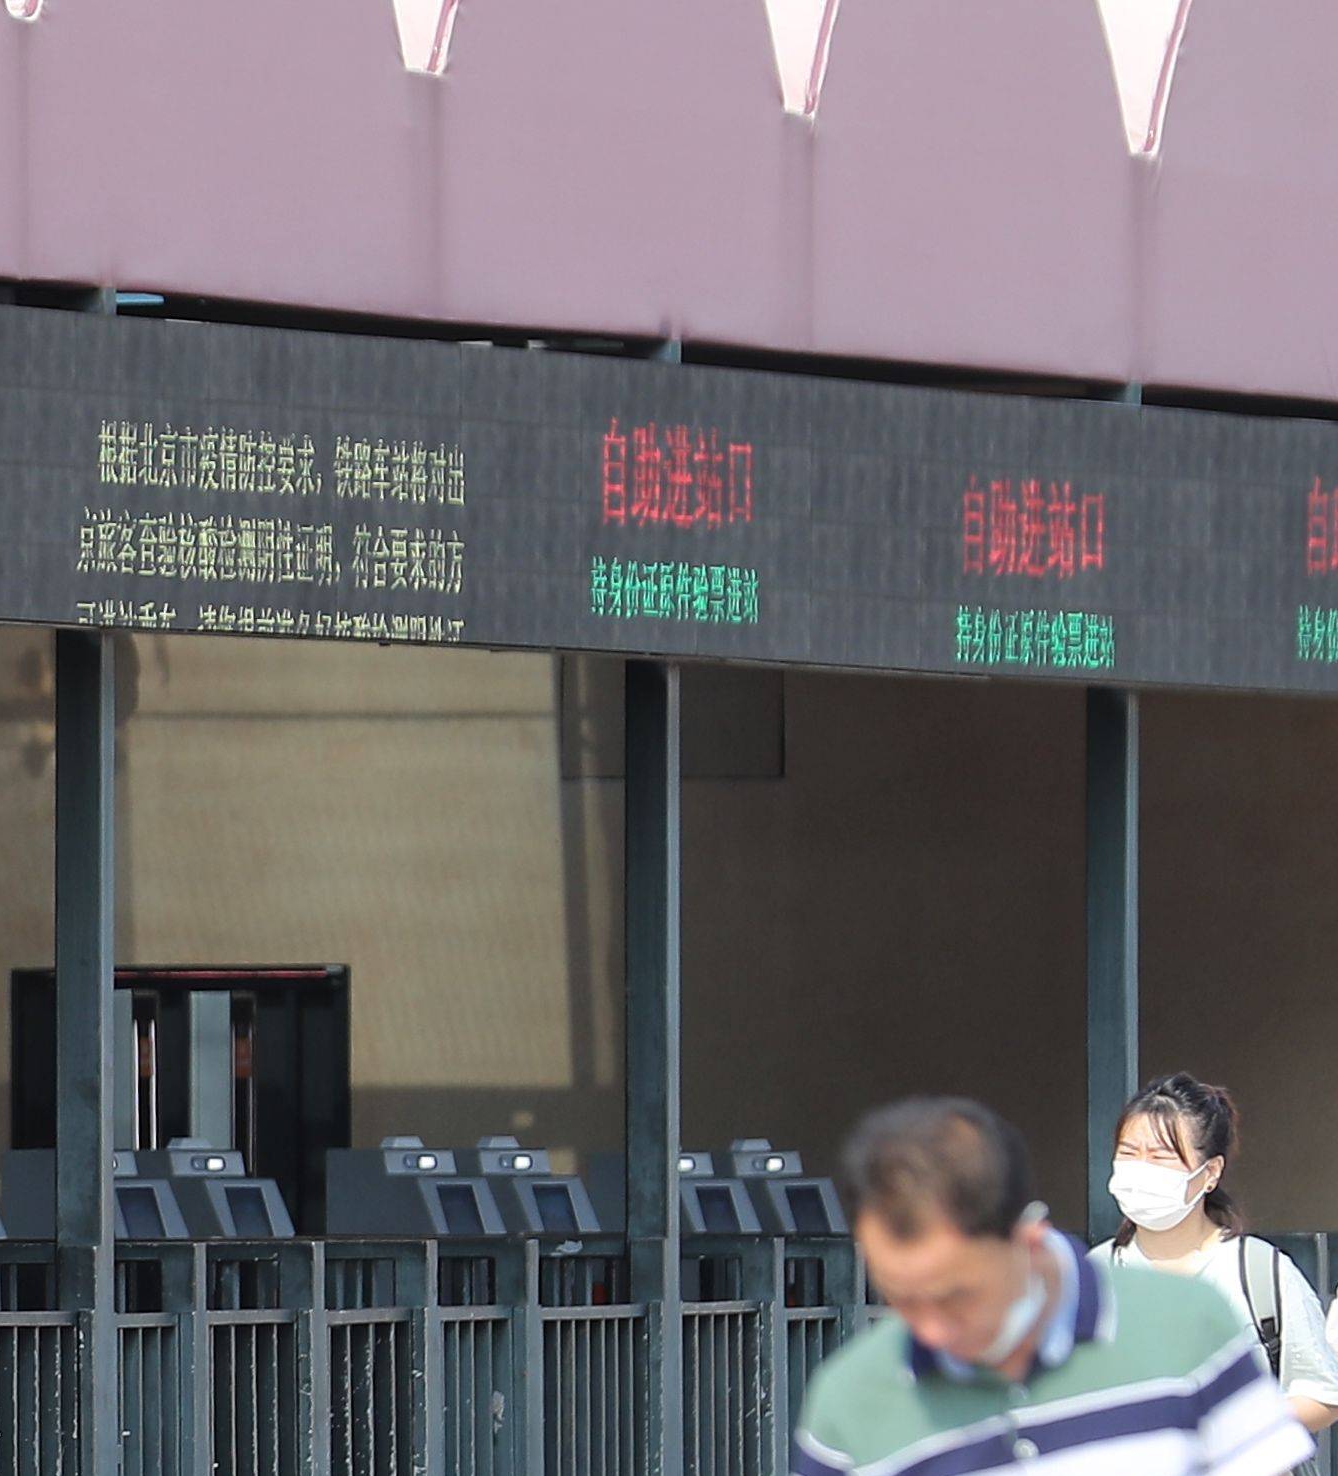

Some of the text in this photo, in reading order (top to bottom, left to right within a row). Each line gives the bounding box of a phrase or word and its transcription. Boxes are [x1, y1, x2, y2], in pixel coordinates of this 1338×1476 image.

[601, 417, 754, 529] 自助进站口
[963, 475, 1105, 578] 自助进站口
[589, 557, 760, 625] 持身份证原件验票进站
[953, 605, 1116, 670] 持身份证原件验票进站
